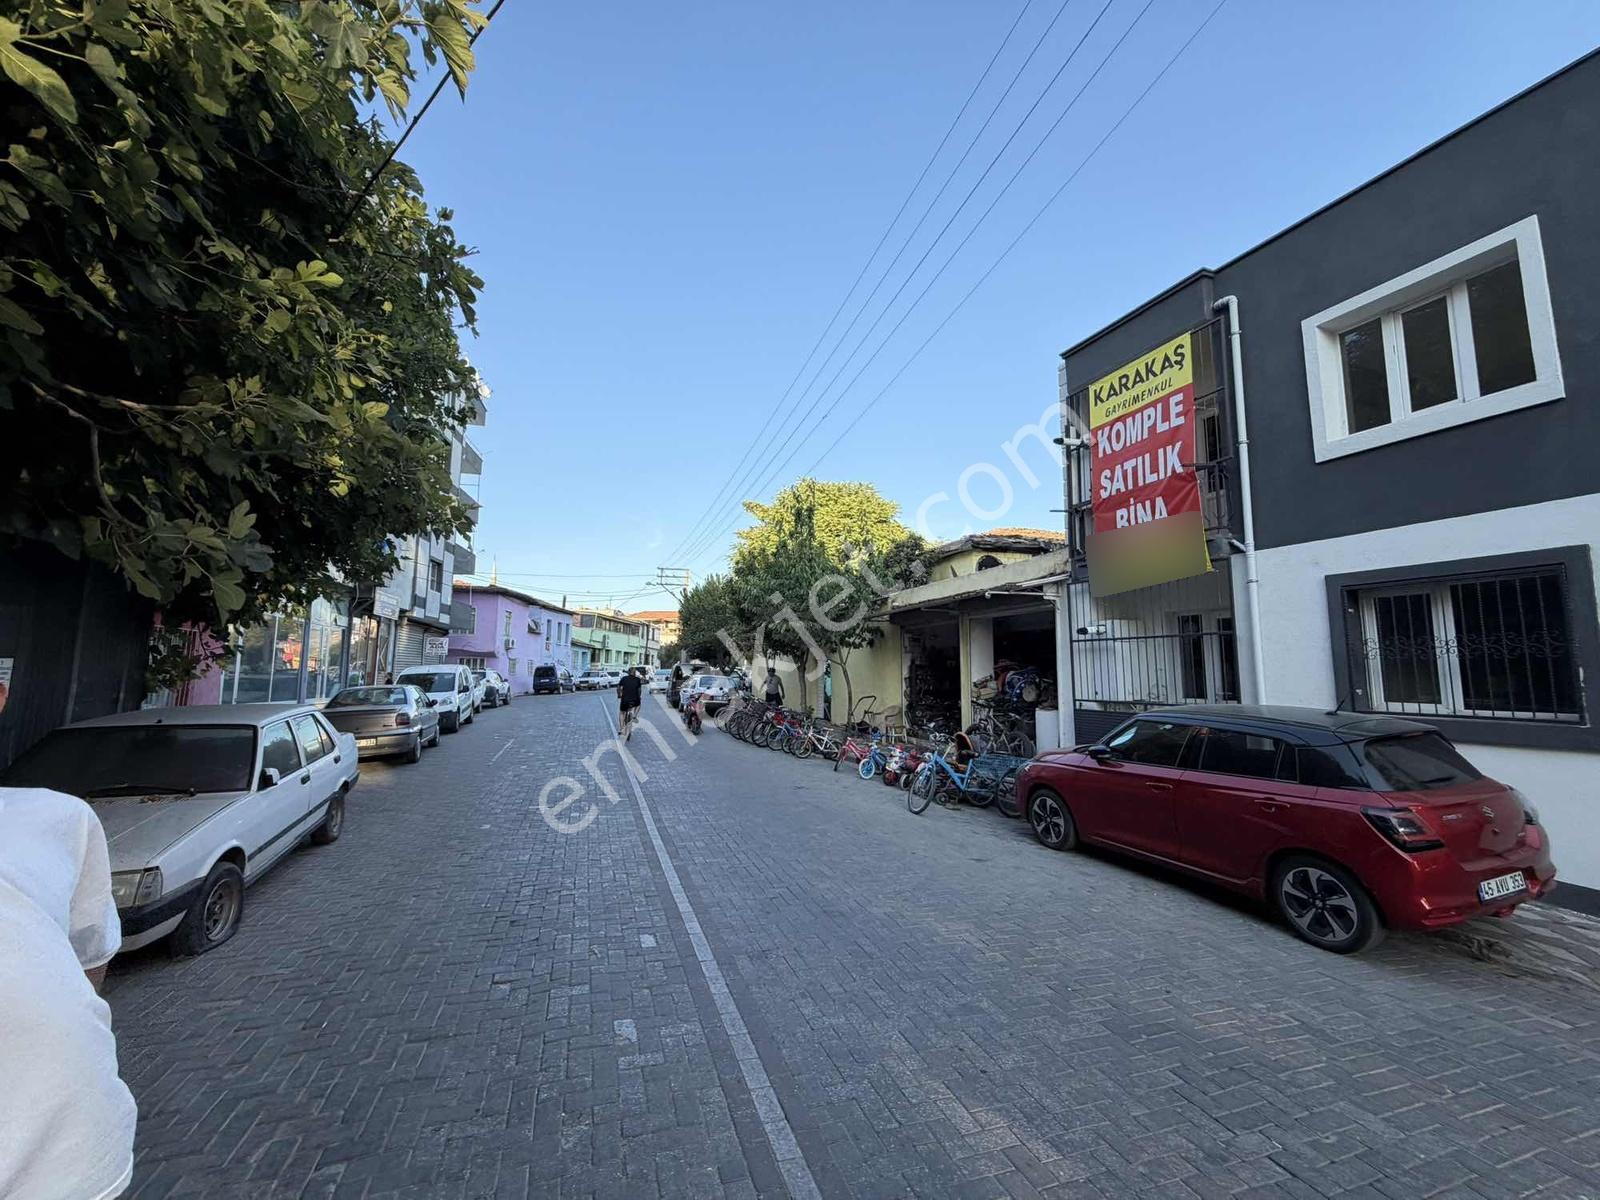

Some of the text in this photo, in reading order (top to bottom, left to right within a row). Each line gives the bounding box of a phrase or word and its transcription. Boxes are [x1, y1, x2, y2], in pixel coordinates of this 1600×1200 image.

[1094, 344, 1185, 407] KARAKAŞ
[1105, 377, 1172, 418] GAYRİMENKUL
[1097, 393, 1185, 458] KOMPLE
[1100, 441, 1183, 499] SATILIK
[1483, 882, 1494, 897] 45
